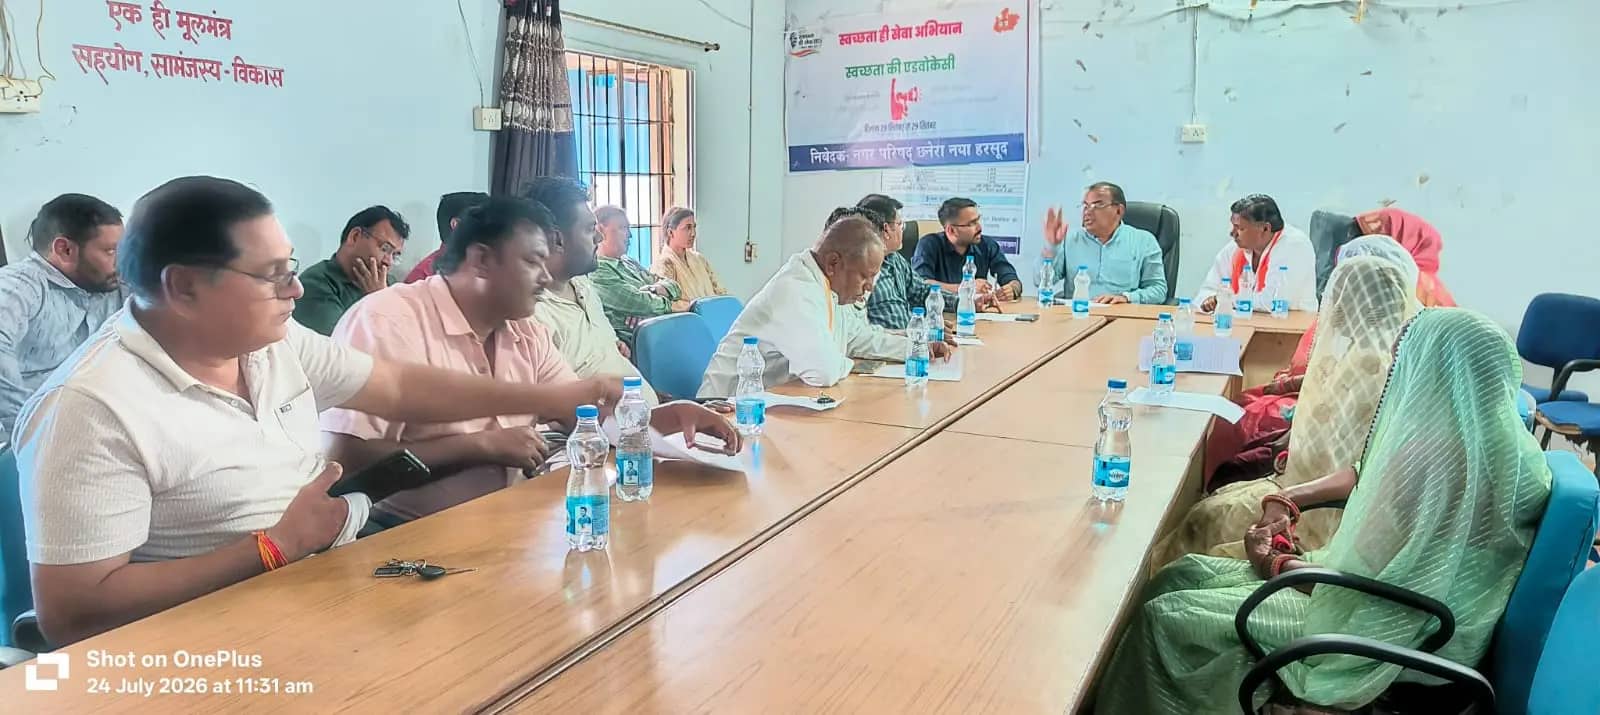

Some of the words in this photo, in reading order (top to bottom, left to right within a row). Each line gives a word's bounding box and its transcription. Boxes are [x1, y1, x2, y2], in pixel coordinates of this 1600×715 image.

[106, 0, 142, 31] एक
[150, 0, 171, 40] ही
[176, 10, 233, 44] मूलमंत्र
[838, 30, 877, 46] स्वच्छता
[879, 24, 890, 43] ही
[892, 24, 913, 41] सेवा
[915, 20, 963, 39] अभियान
[845, 64, 885, 79] स्वच्छता
[887, 57, 902, 75] की
[903, 53, 956, 74] एडवोकेसी
[948, 142, 971, 158] नया
[975, 140, 1009, 160] हरसूद
